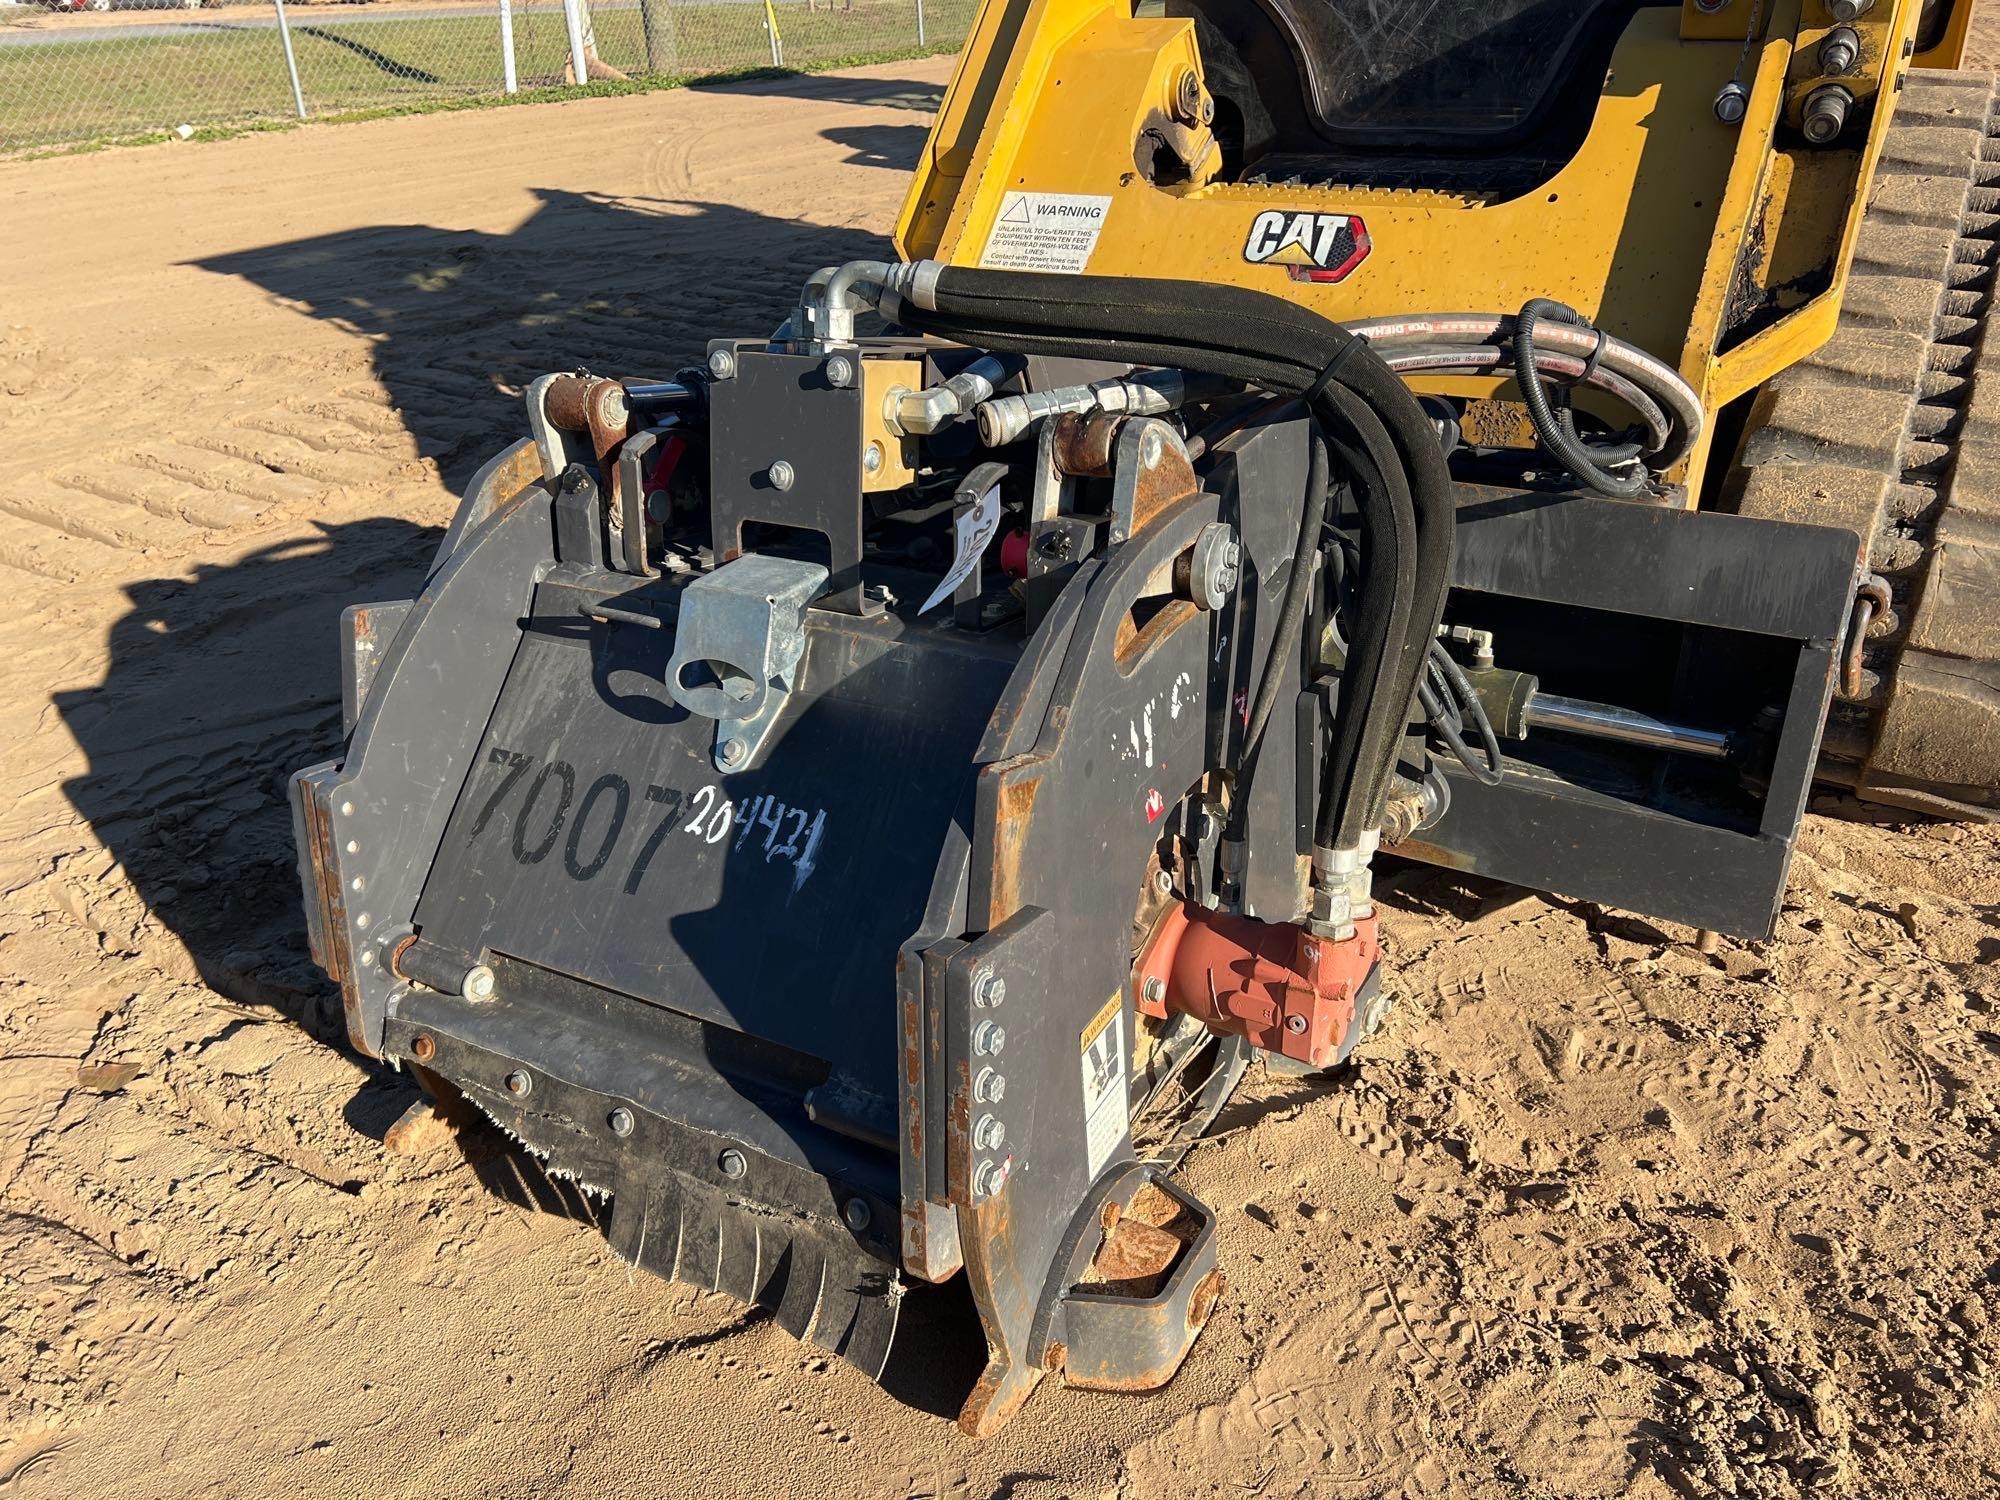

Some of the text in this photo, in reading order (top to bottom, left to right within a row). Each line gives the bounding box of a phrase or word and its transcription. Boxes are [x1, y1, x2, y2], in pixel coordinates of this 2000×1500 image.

[1037, 204, 1102, 218] WARNING
[998, 226, 1033, 234] UNLAWUL
[1044, 228, 1075, 236] OERATE
[1002, 240, 1038, 248] OVERHEAD
[1245, 211, 1349, 266] CAT
[466, 747, 694, 895] 7007
[1089, 995, 1121, 1037] WARNING
